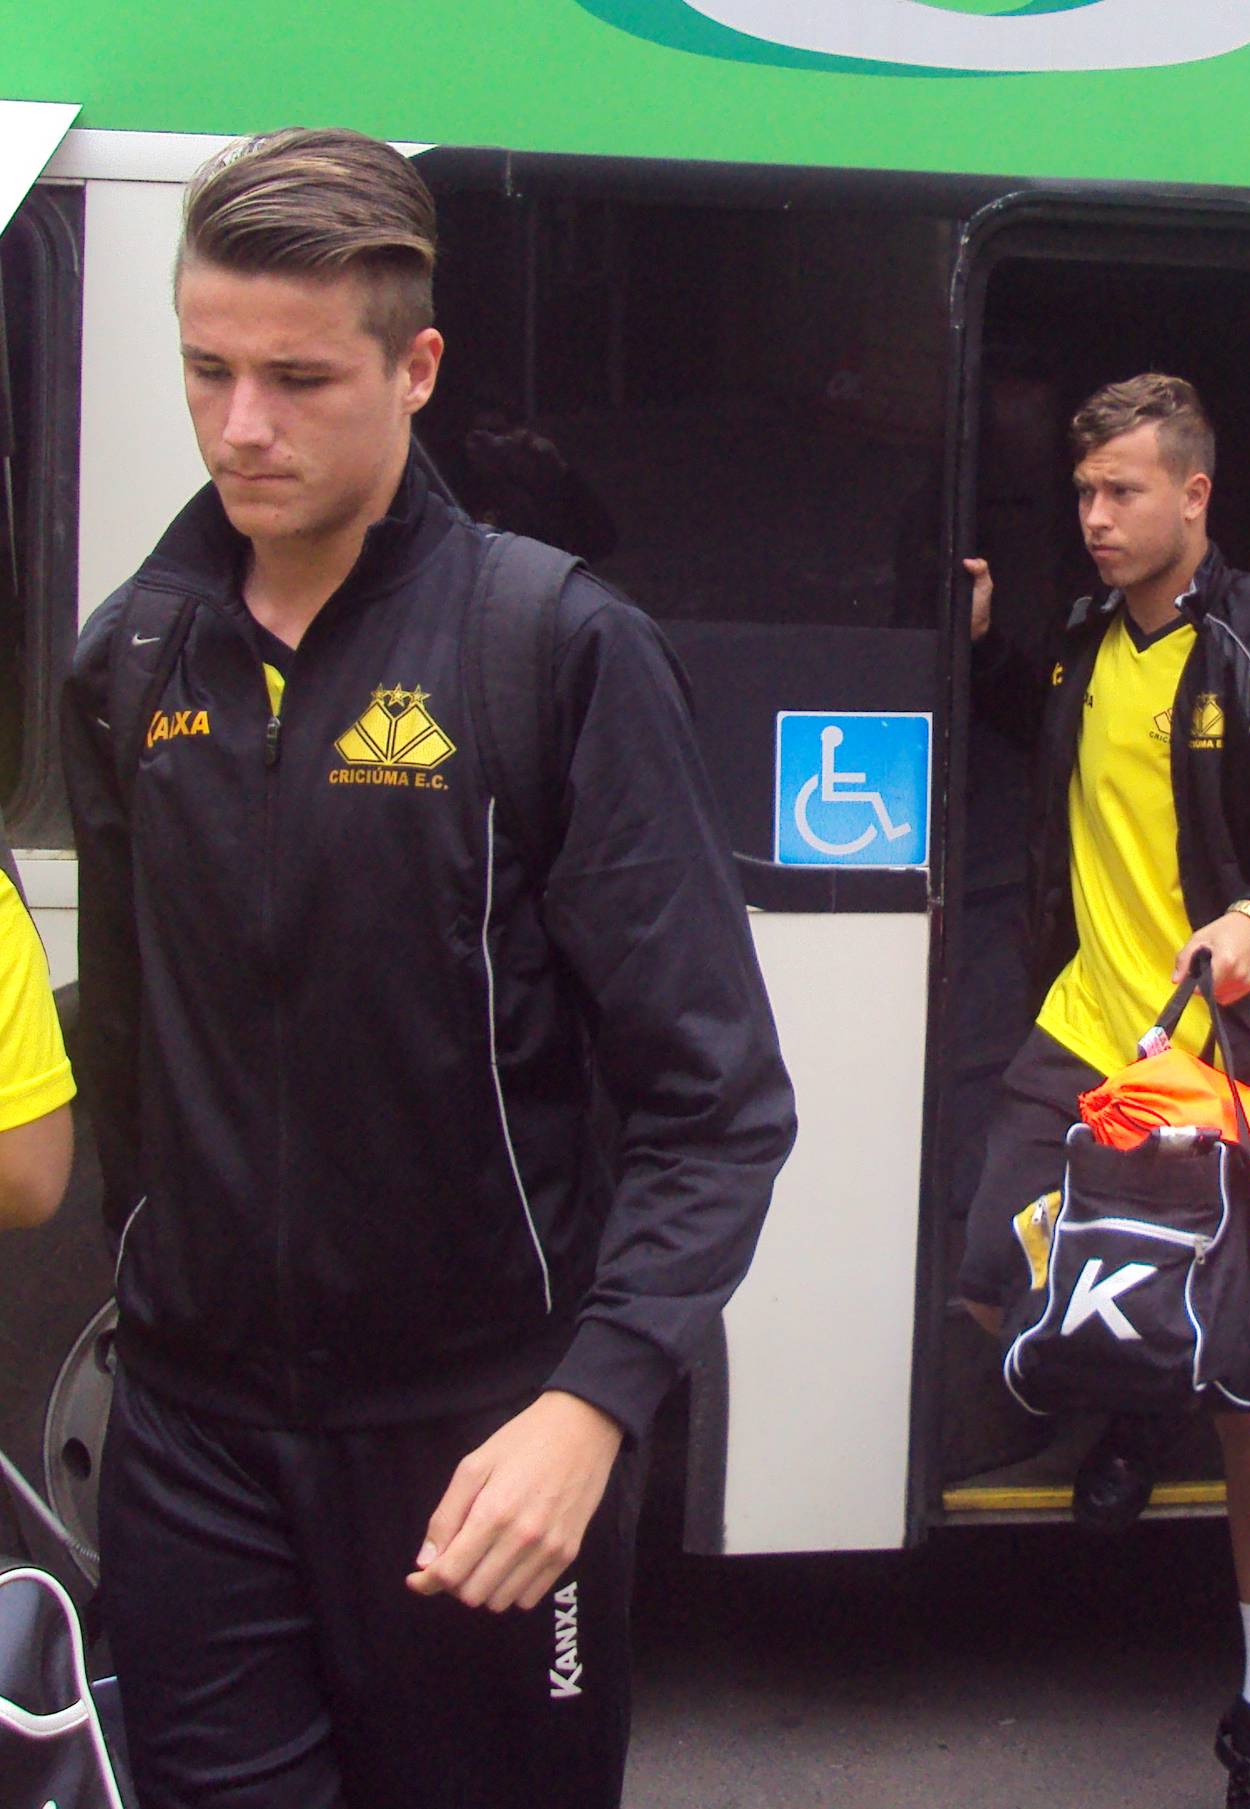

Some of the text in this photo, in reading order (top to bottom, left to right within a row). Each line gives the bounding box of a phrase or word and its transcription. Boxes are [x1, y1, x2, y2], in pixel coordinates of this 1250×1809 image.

[329, 767, 449, 790] CRICIÚMA E.C.
[1060, 1258, 1158, 1340] K
[549, 1580, 583, 1698] KANXA
